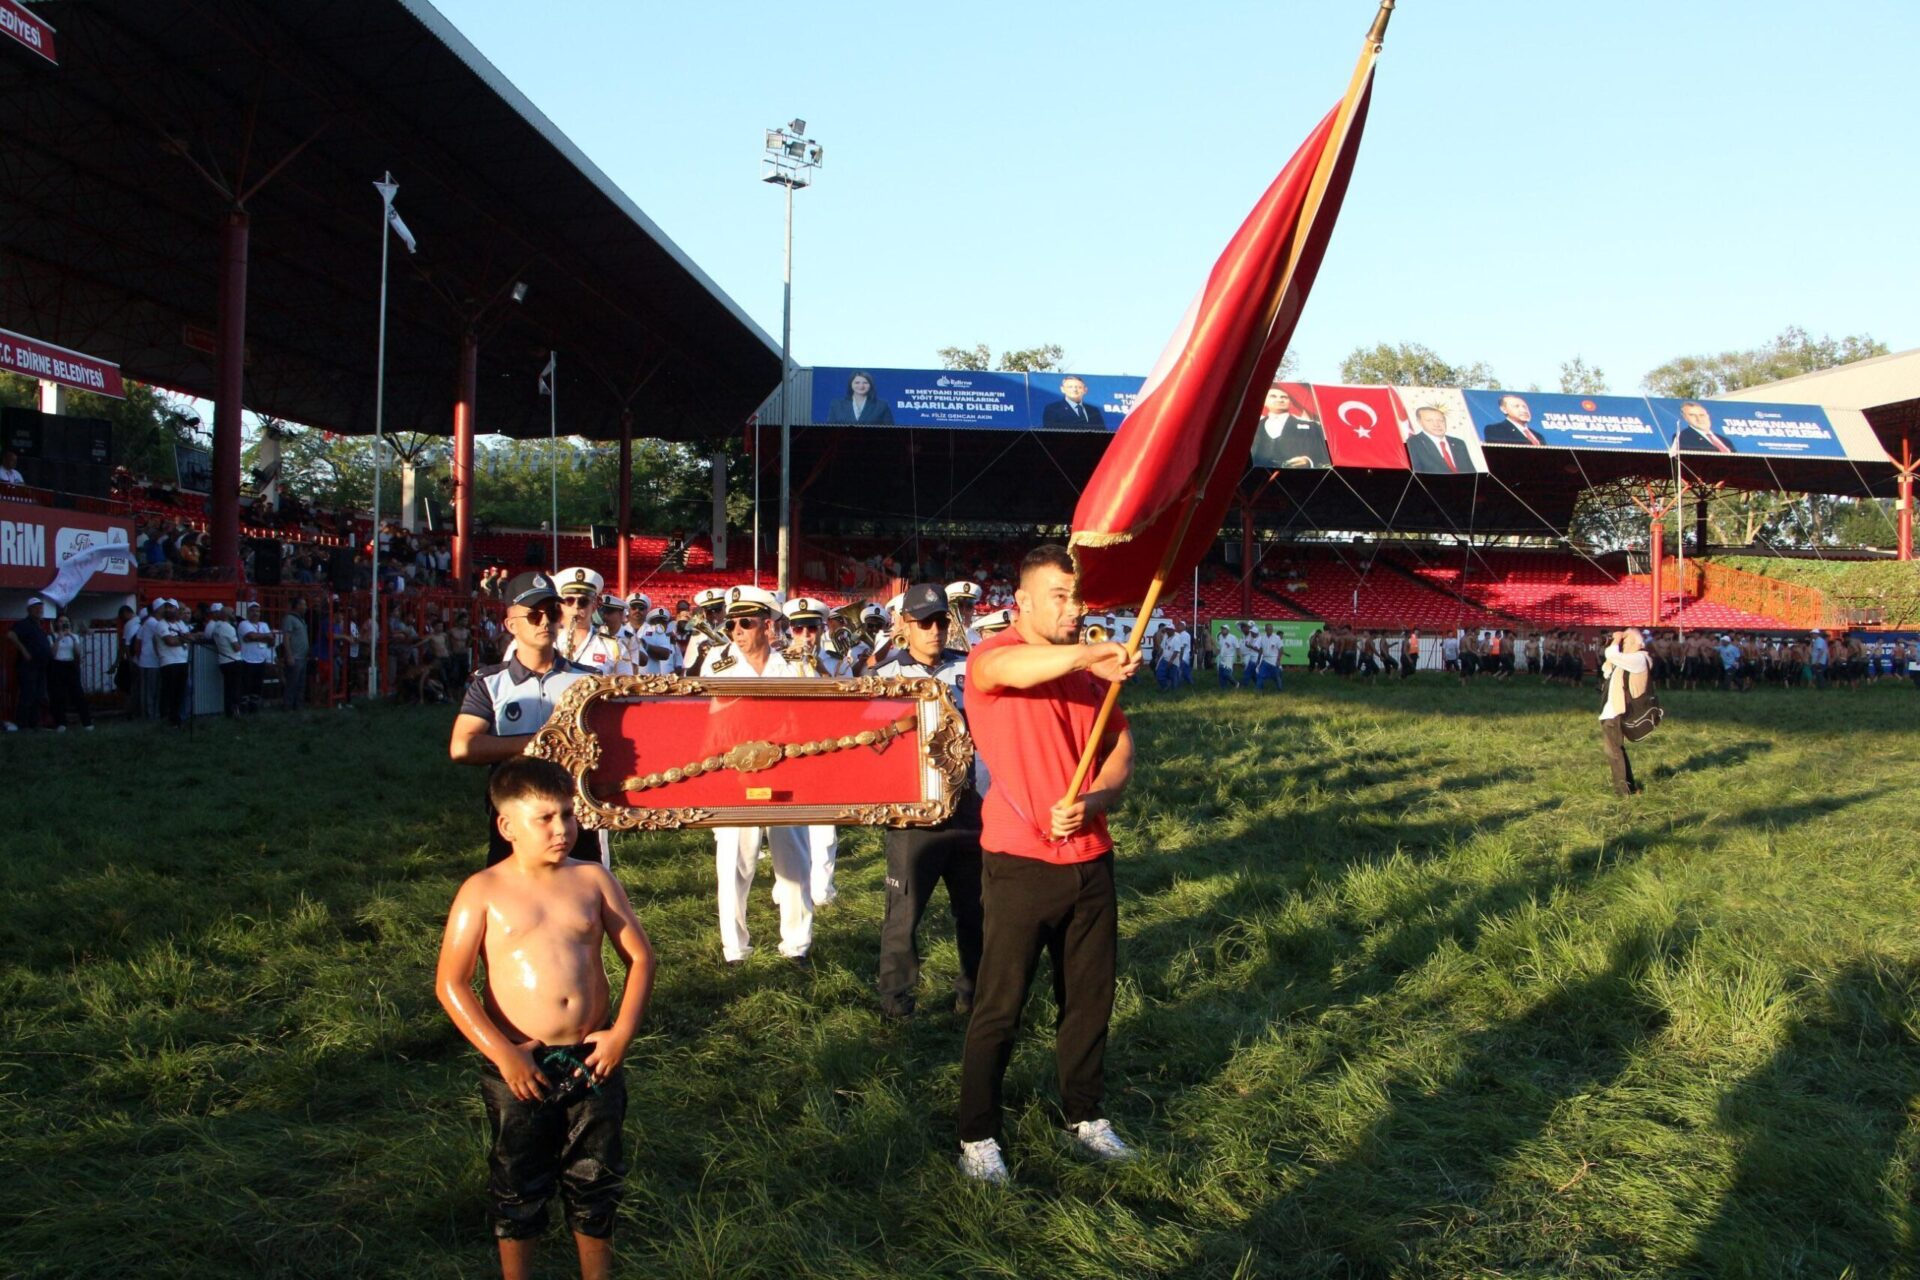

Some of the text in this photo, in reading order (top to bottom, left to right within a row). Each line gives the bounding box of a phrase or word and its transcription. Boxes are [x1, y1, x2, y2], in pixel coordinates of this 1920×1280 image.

[16, 347, 51, 375] EDİRNE
[53, 358, 104, 389] BELEDİYESİ
[897, 401, 964, 411] BAŞARILAR
